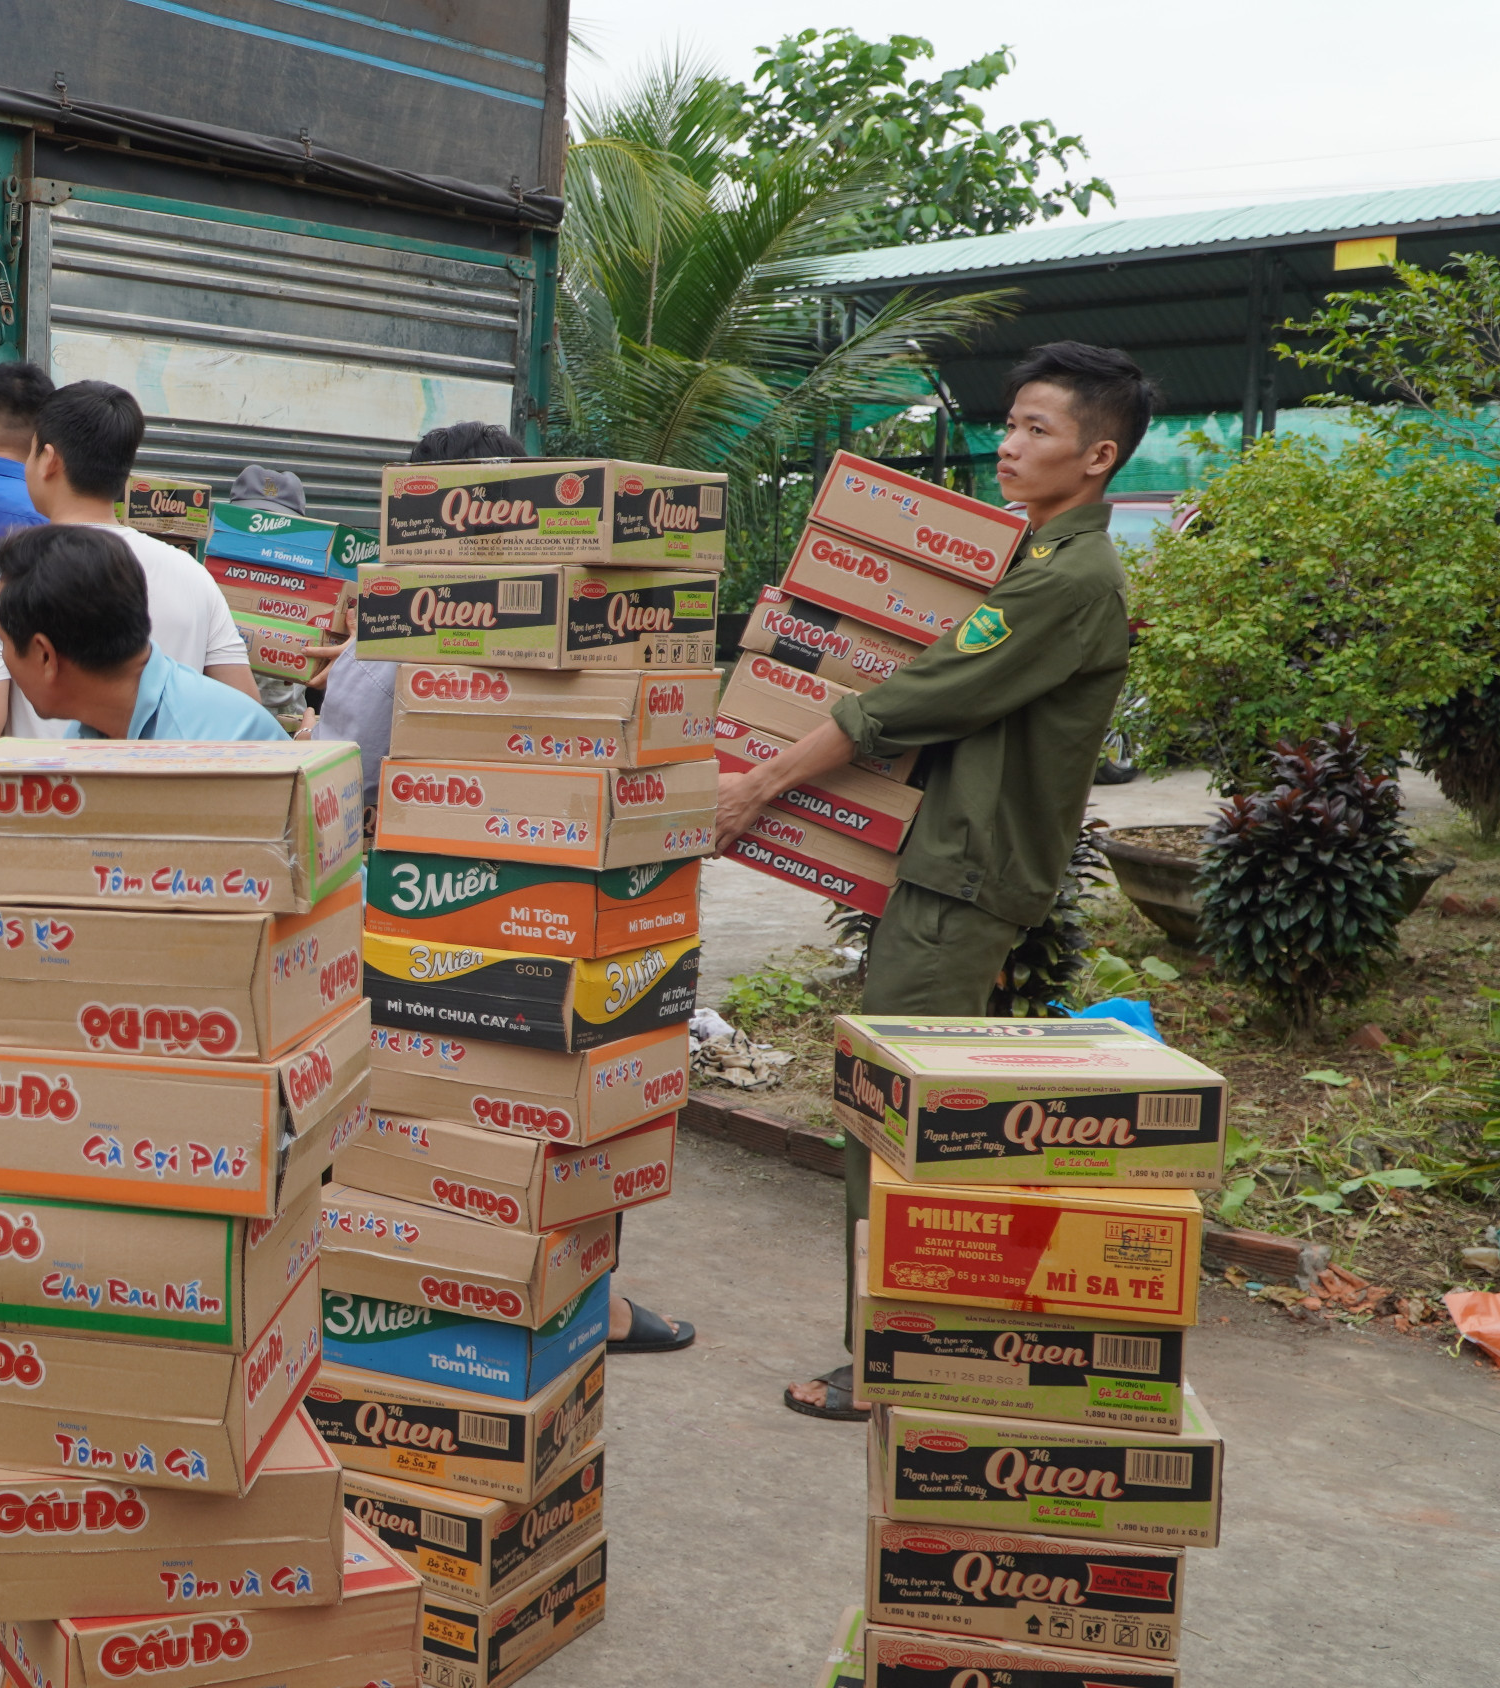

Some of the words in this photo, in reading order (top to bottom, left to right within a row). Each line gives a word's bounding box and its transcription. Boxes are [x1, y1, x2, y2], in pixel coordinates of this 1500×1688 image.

[845, 474, 867, 493] Gà
[870, 485, 889, 501] và
[441, 487, 539, 532] Quen
[649, 489, 699, 534] Quen
[892, 490, 921, 516] Tôm
[459, 537, 478, 545] CÔNG
[563, 537, 578, 546] VIỆT
[224, 566, 248, 579] CAY
[250, 571, 278, 586] CHUA
[280, 577, 306, 591] TÔM
[411, 588, 498, 633] Quen
[607, 593, 674, 638] Quen
[761, 609, 853, 659] KOKOMI
[852, 648, 897, 680] 30+3
[716, 721, 737, 737] MỚI
[787, 790, 832, 818] CHUA
[834, 809, 871, 830] CAY
[737, 840, 772, 864] TÔM
[773, 855, 817, 883] CHUA
[820, 874, 857, 895] CAY
[93, 865, 143, 892] Tôm
[152, 866, 215, 896] Chua
[223, 868, 270, 902] Cay
[510, 906, 530, 921] Mì
[532, 907, 569, 925] Tôm
[639, 918, 654, 930] Tôm
[656, 915, 672, 927] Chua
[673, 912, 686, 925] Cay
[35, 920, 75, 951] Gà
[500, 921, 542, 939] Chua
[545, 926, 577, 944] Cay
[516, 963, 553, 978] GOLD
[387, 1000, 403, 1013] MÌ
[405, 1001, 435, 1019] TÔM
[438, 1008, 477, 1025] CHUA
[480, 1012, 508, 1029] CAY
[942, 1096, 987, 1107] ACECOOK
[1047, 1100, 1067, 1114] Mì
[1004, 1100, 1137, 1152] Quen
[83, 1135, 123, 1167] Gà
[133, 1139, 179, 1177] Sợi
[187, 1143, 248, 1177] Phở
[940, 1144, 962, 1154] Quen
[983, 1139, 1006, 1156] ngày
[1054, 1157, 1067, 1169] Gà
[1083, 1158, 1110, 1168] Chanh
[1150, 1170, 1159, 1179] kg
[907, 1206, 1015, 1236] MILIKET
[915, 1246, 955, 1258] INSTANT
[958, 1249, 1004, 1262] NOODLES
[925, 1237, 954, 1248] SATAY
[955, 1239, 997, 1251] FLAVOUR
[42, 1273, 101, 1308] Chay
[108, 1279, 157, 1308] Rau
[165, 1280, 220, 1312] Nấm
[957, 1271, 969, 1280] 65
[970, 1274, 977, 1283] g
[980, 1273, 986, 1281] x
[989, 1273, 1001, 1282] 30
[1003, 1273, 1027, 1286] bags
[1046, 1268, 1077, 1293] MÌ
[1086, 1277, 1120, 1297] SA
[1129, 1274, 1165, 1300] TẾ
[993, 1331, 1089, 1367] Quen
[428, 1353, 465, 1373] Tôm
[468, 1362, 510, 1382] Hùm
[961, 1373, 974, 1381] 25
[997, 1377, 1013, 1385] SG
[355, 1402, 459, 1453] Quen
[55, 1434, 113, 1465] Tôm
[124, 1444, 156, 1474] và
[164, 1448, 208, 1481] Gà
[985, 1448, 1124, 1498] Quen
[354, 1498, 419, 1538] Quen
[160, 1572, 219, 1601] Tôm
[229, 1570, 260, 1596] và
[270, 1567, 312, 1595] Gà
[953, 1552, 1087, 1605] Quen
